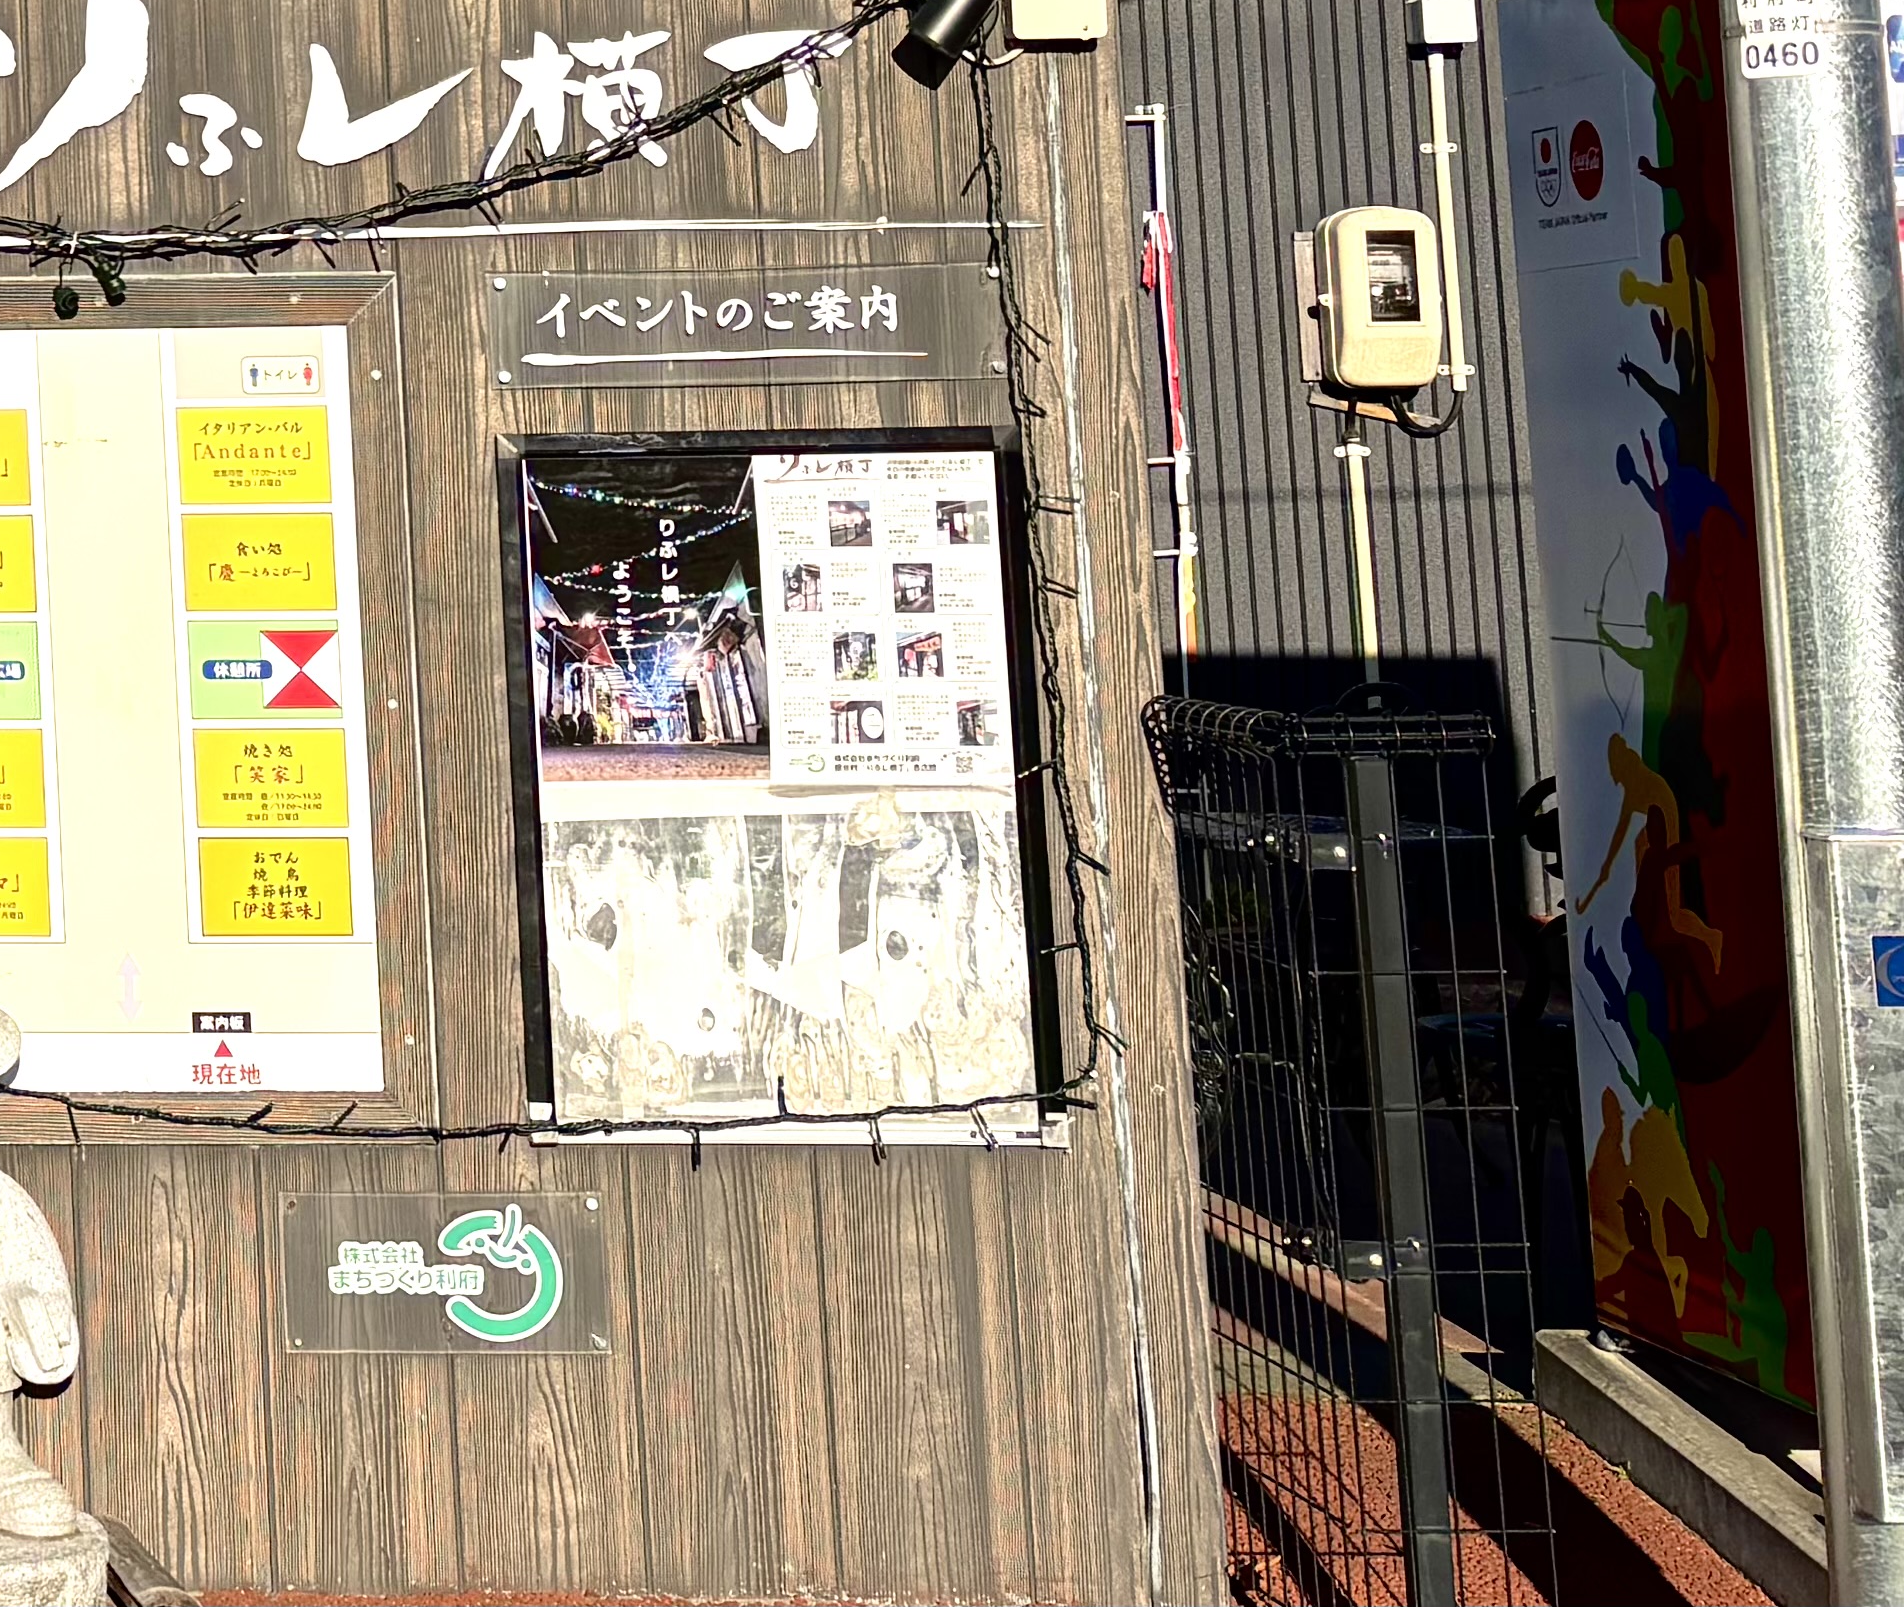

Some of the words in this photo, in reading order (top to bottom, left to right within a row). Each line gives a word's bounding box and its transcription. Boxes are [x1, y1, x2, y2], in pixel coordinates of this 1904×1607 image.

[1749, 16, 1809, 34] 道路灯
[1746, 41, 1819, 69] 0460
[536, 286, 899, 338] イベントのご案内
[263, 369, 298, 381] トイレ
[198, 421, 303, 436] イタリアン・バル
[237, 542, 282, 556] 食い処
[213, 662, 262, 679] 休憩所
[243, 744, 293, 758] 焼き処
[253, 851, 299, 864] おでん
[247, 884, 308, 898] 季節料理
[192, 1063, 262, 1085] 現在地
[342, 1246, 419, 1265] 株式会社
[332, 1268, 479, 1290] まちづくり利府
